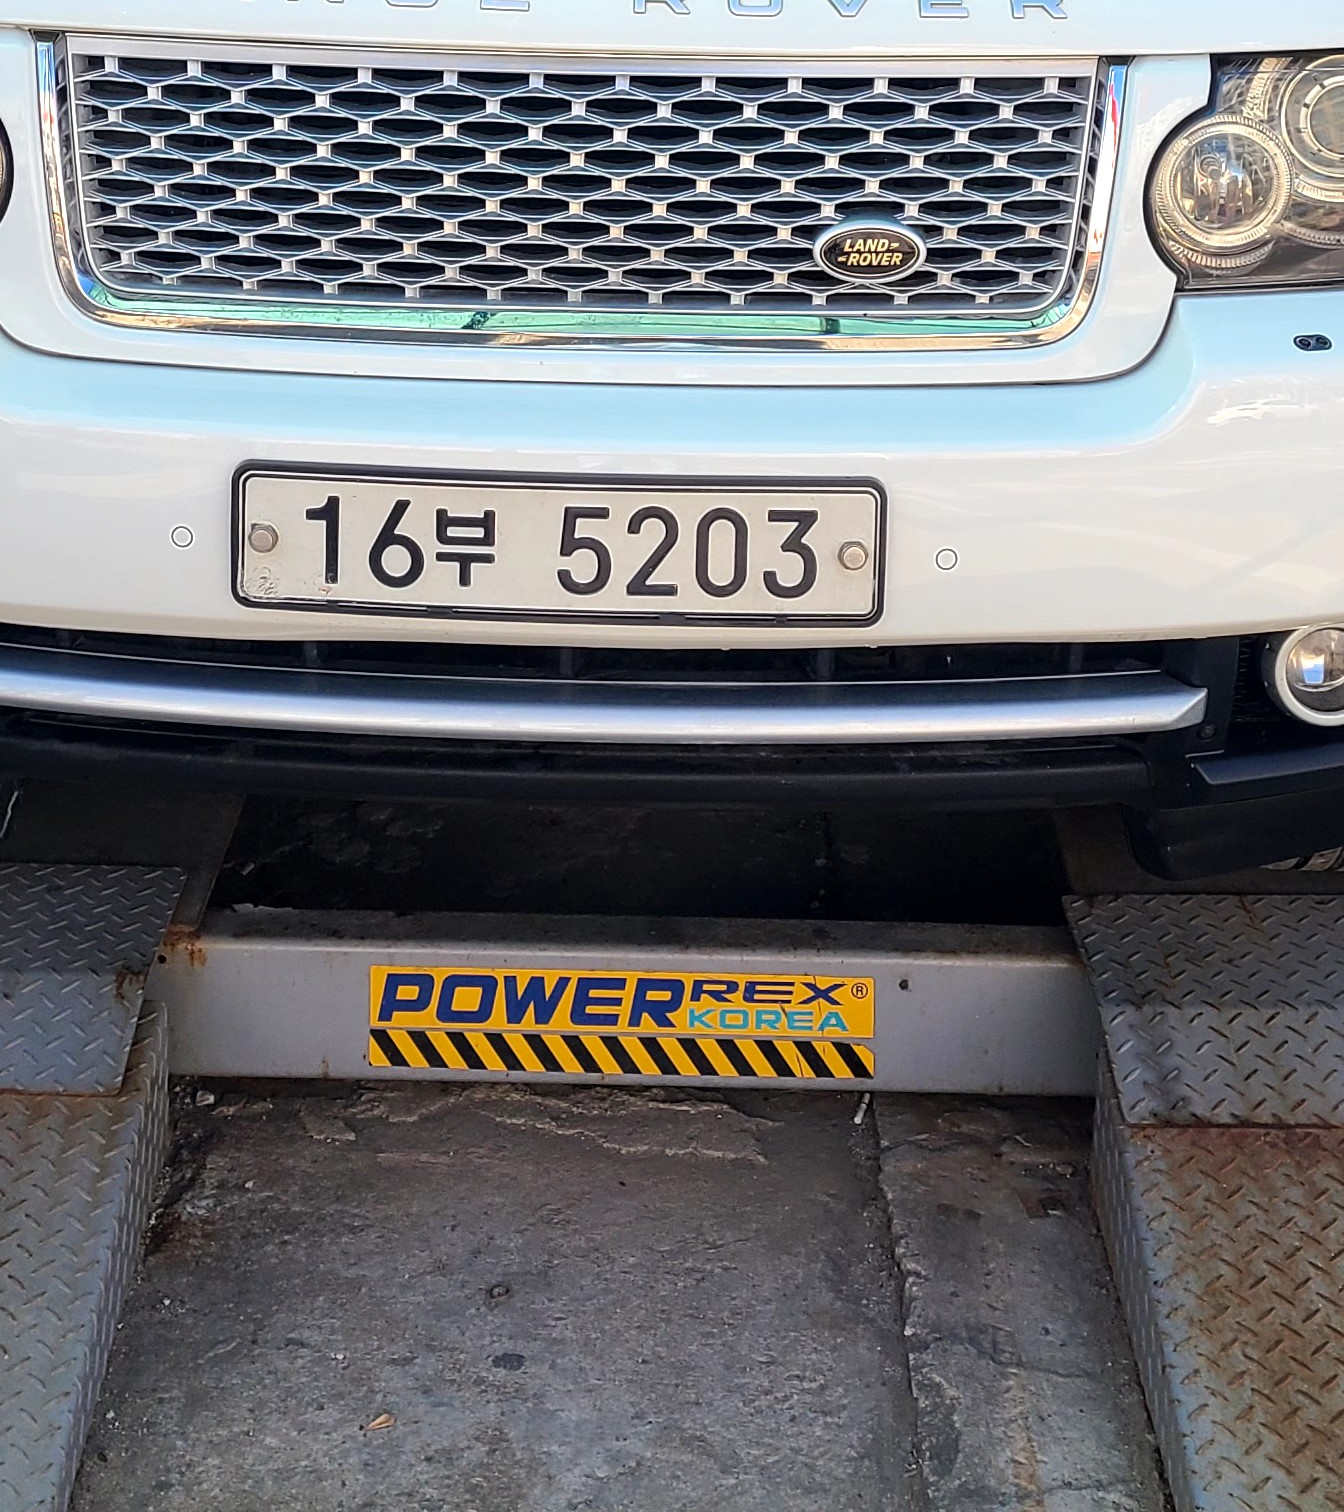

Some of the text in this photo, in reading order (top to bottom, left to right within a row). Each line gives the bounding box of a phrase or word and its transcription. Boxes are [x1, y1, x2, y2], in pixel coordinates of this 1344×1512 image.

[305, 495, 820, 600] 16부 5203
[688, 1008, 851, 1033] KOREA
